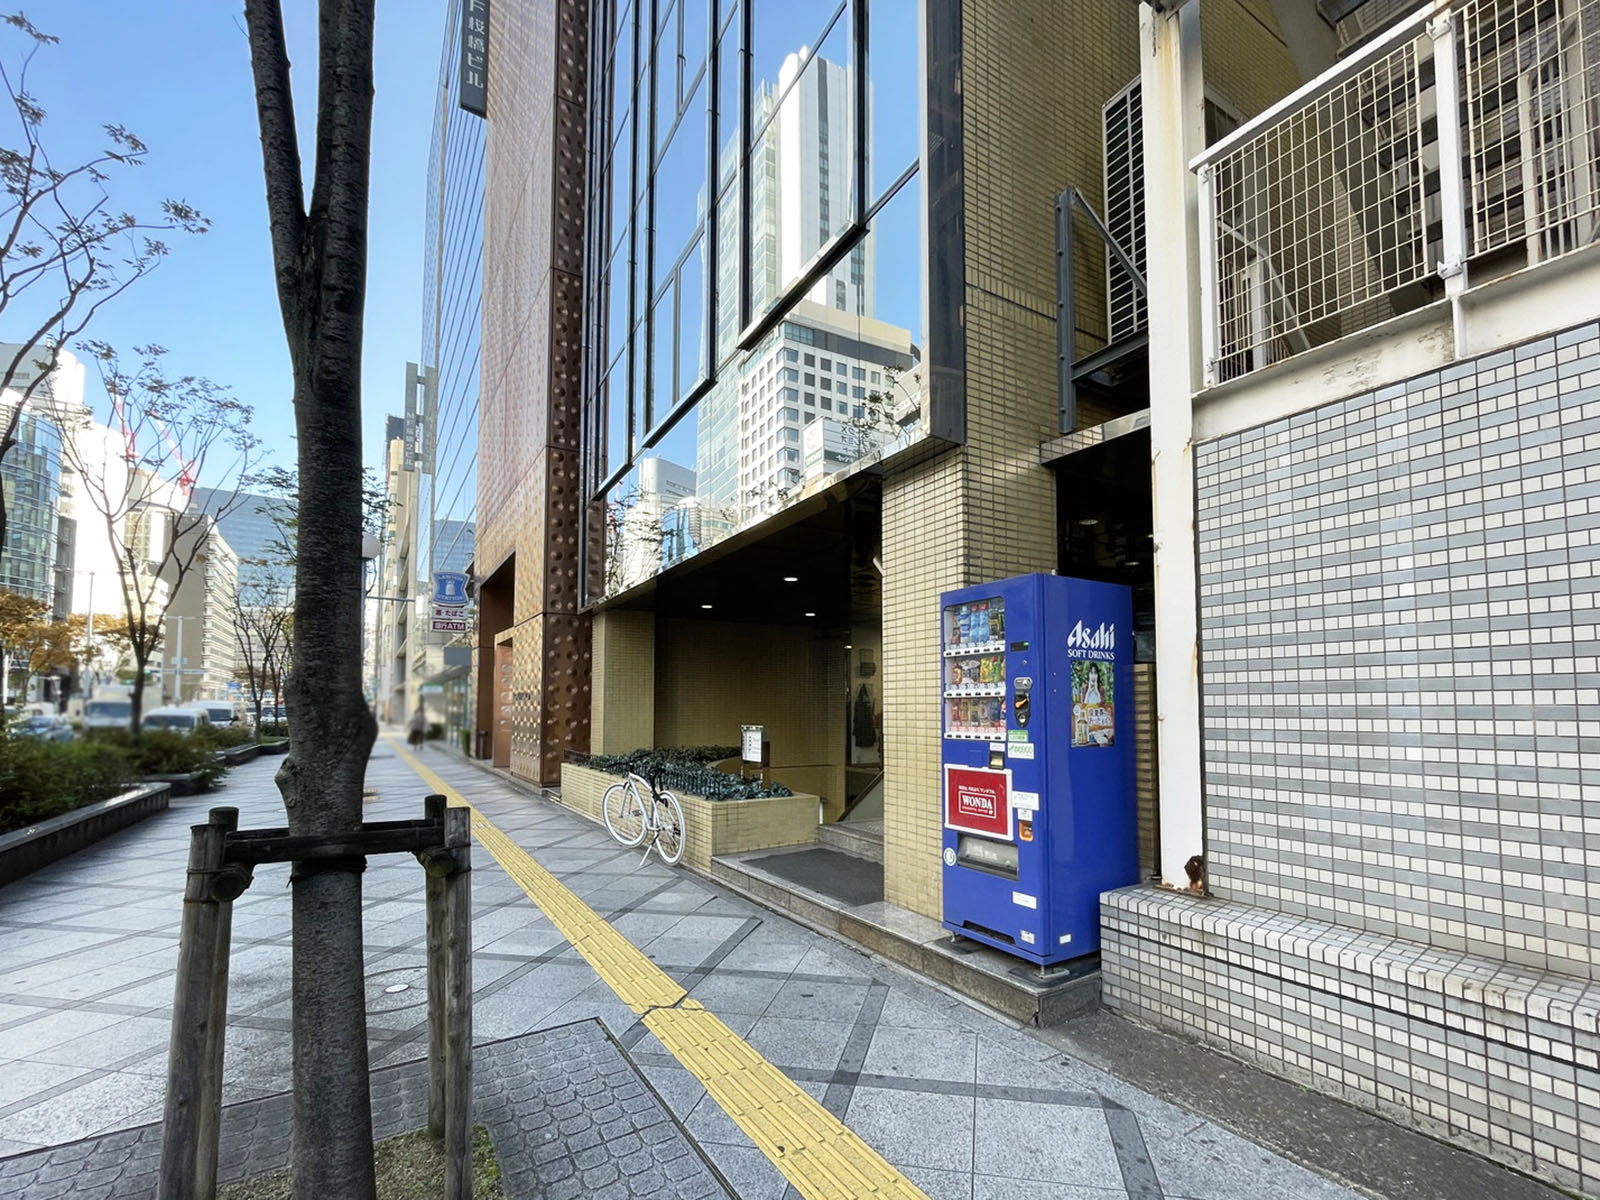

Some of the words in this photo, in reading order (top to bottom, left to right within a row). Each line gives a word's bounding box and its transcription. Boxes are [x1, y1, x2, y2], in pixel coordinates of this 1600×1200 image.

[1067, 619, 1115, 650] Asahi
[1067, 649, 1087, 658] SOFT
[1088, 650, 1115, 661] DRINKS
[961, 795, 993, 810] WONDA
